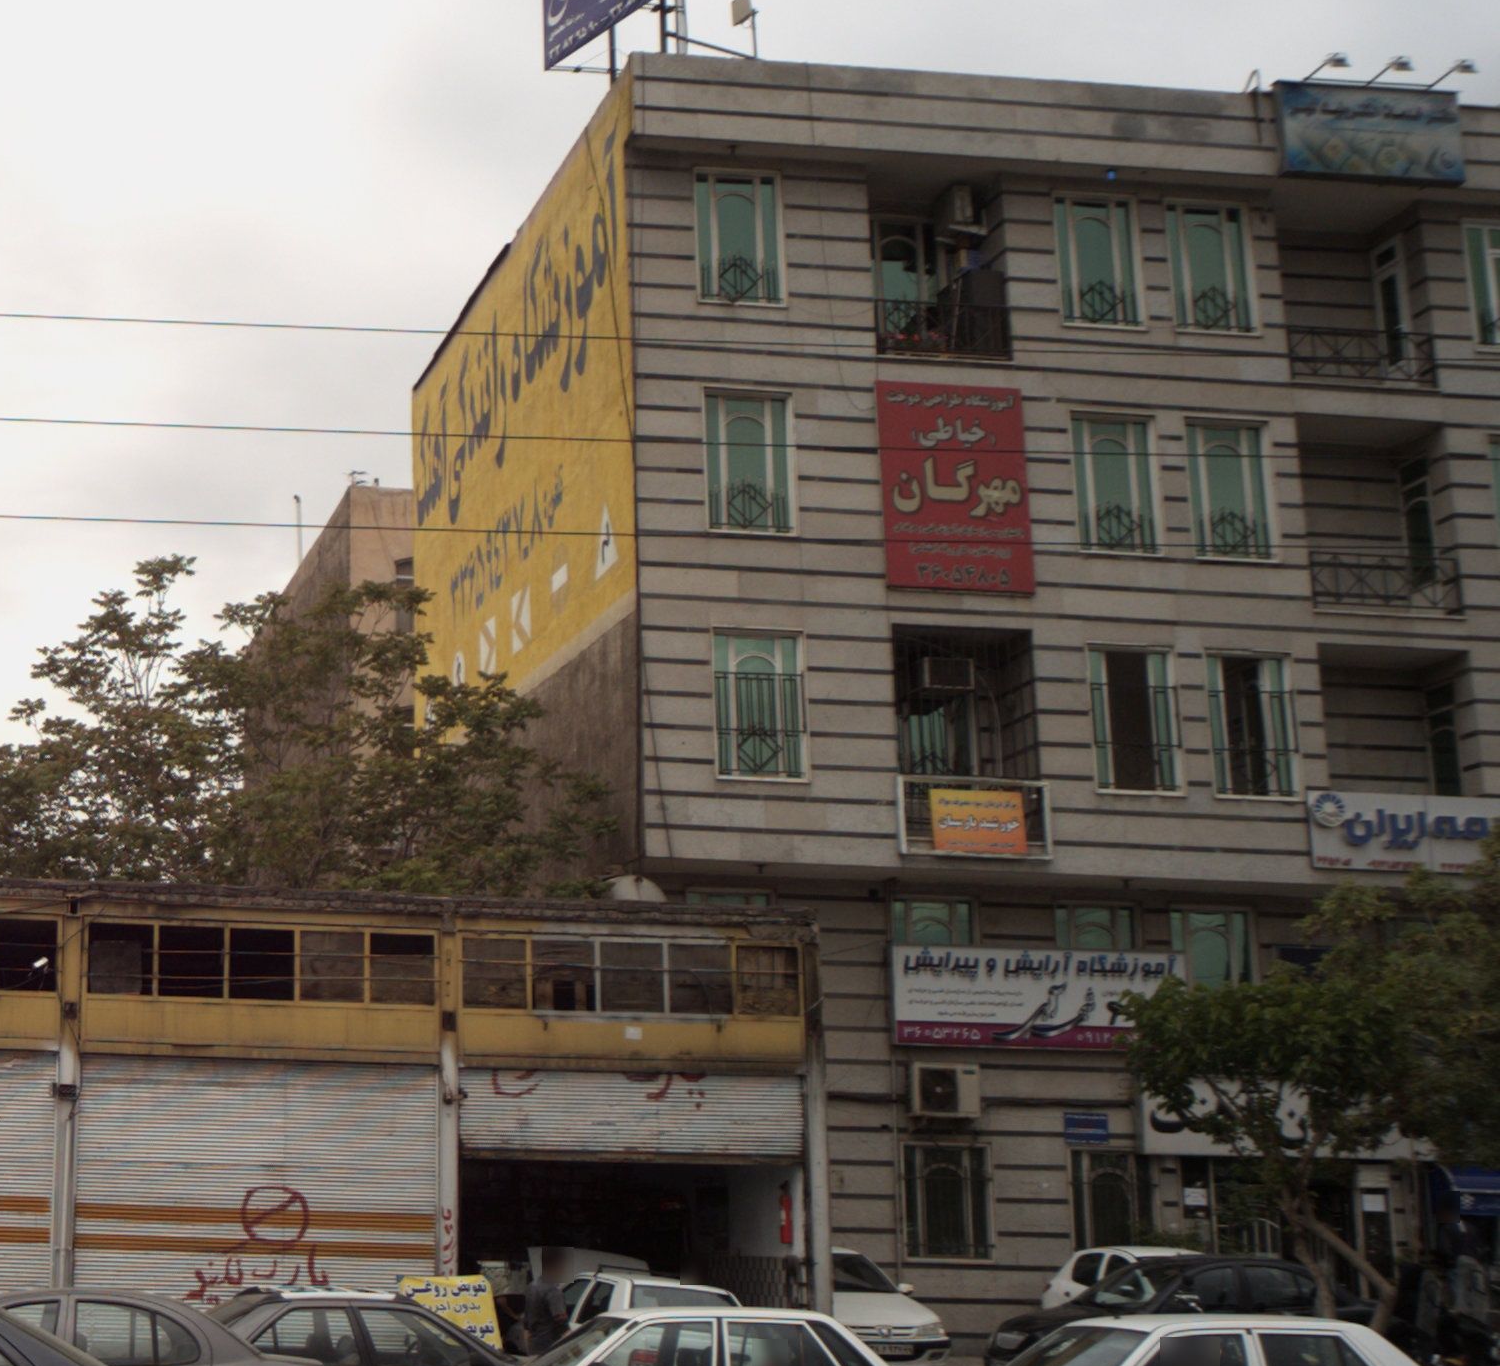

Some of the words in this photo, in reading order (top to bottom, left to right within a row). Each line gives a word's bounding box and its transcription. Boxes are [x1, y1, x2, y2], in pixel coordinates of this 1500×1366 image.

[511, 123, 621, 403] آموزشگاه
[448, 309, 507, 526] رانندگی
[892, 455, 1022, 518] مهرگان
[1344, 807, 1427, 849] ایران
[1432, 815, 1490, 840] مه
[903, 947, 980, 980] پیرایش
[985, 956, 998, 974] و
[1004, 950, 1073, 979] آرایش
[1076, 951, 1177, 978] آموزشگاه
[405, 1280, 448, 1298] روغن
[451, 1279, 487, 1297] تعویض
[453, 1301, 481, 1313] بدون
